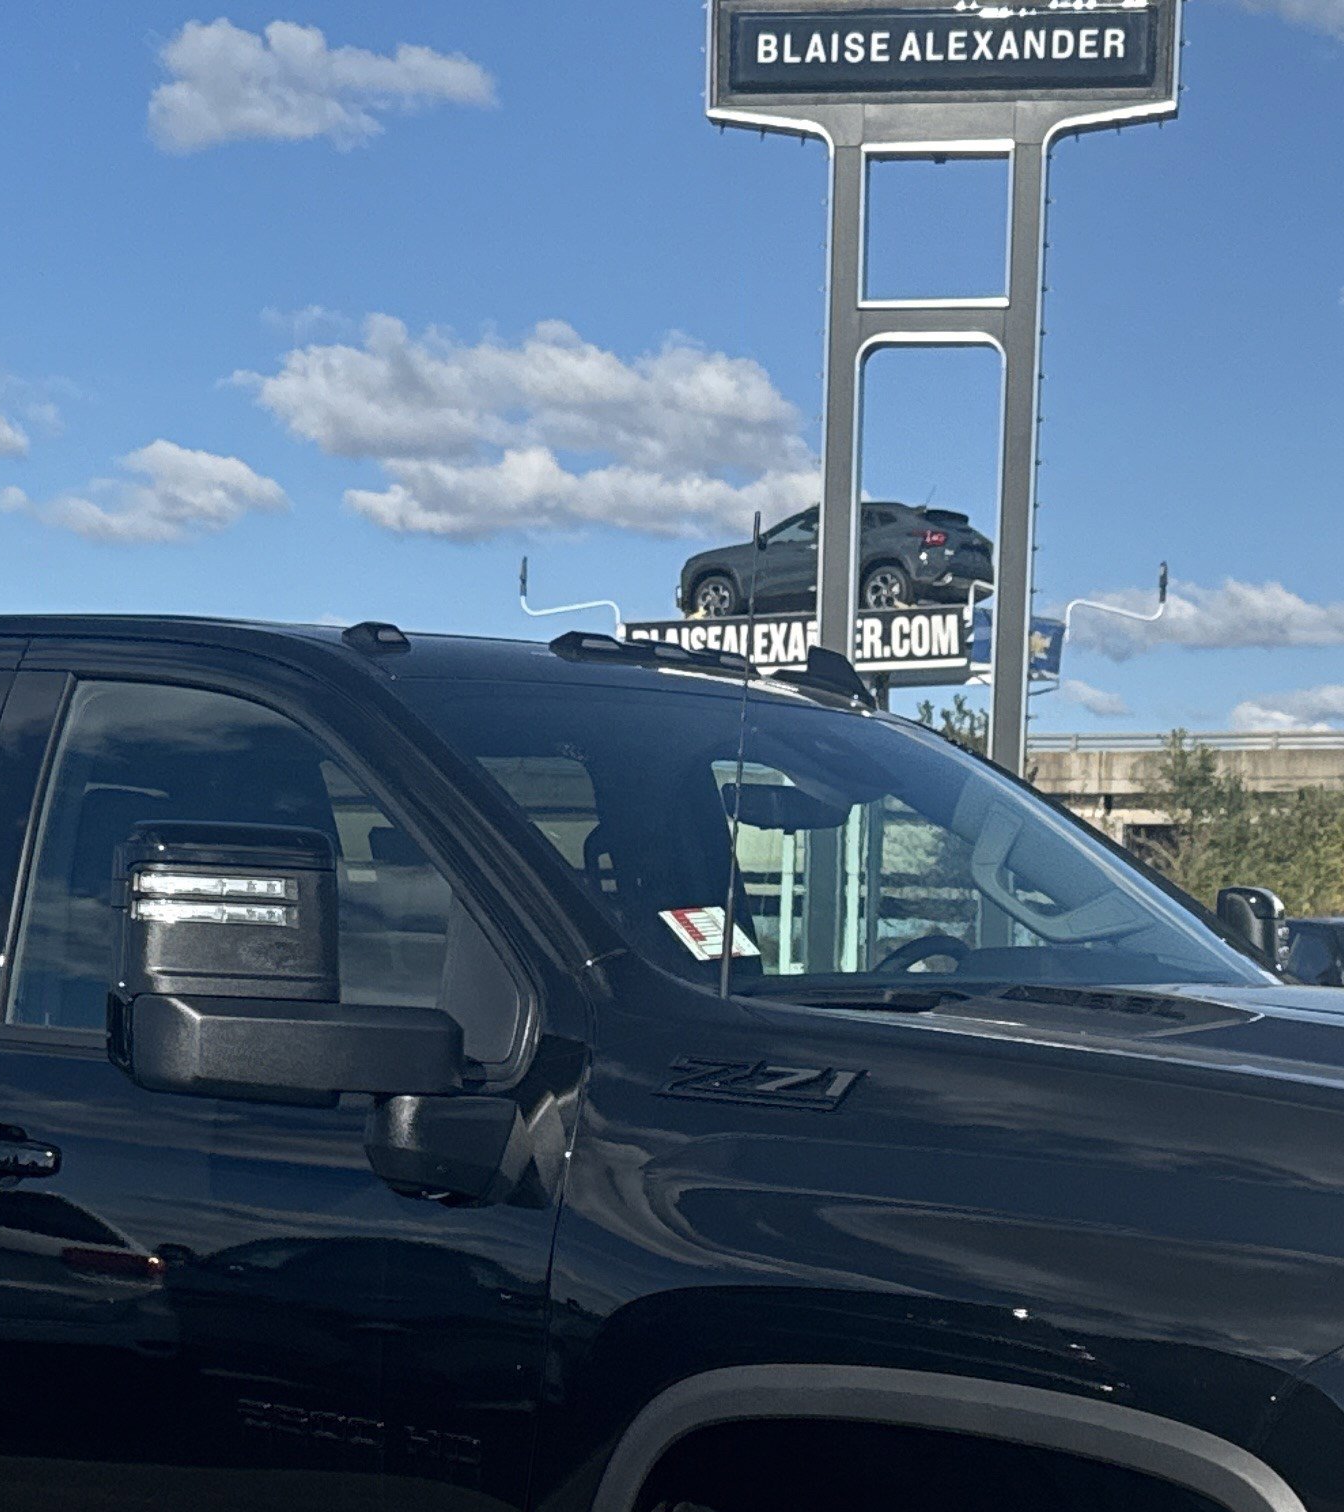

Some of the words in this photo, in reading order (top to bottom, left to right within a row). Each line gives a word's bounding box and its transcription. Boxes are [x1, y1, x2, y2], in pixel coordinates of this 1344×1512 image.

[757, 32, 890, 64] BLAISE
[900, 28, 1126, 62] ALEXANDER
[657, 1056, 868, 1112] Z71
